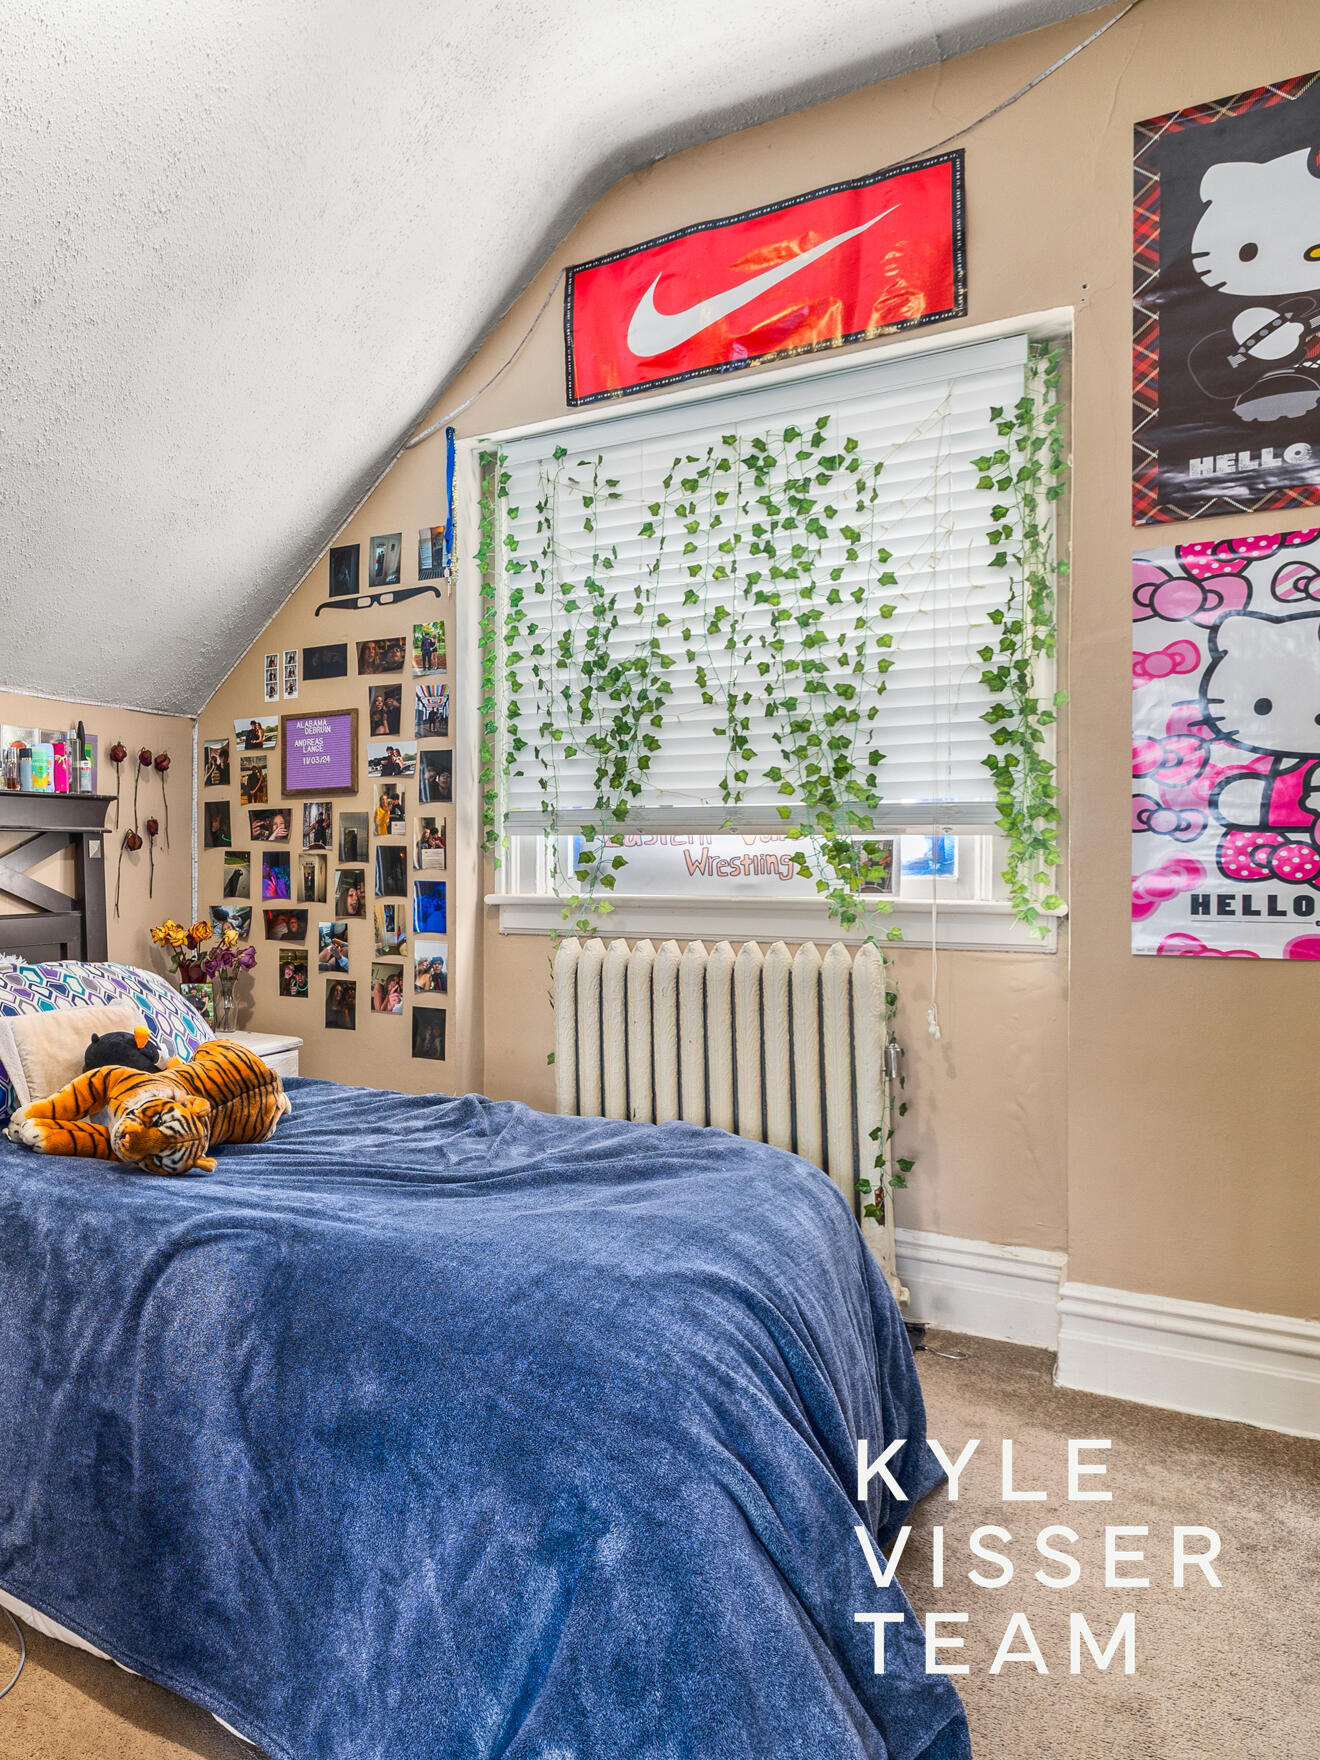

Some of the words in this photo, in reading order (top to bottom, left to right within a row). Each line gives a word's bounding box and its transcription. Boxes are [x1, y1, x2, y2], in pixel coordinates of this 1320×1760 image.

[1189, 442, 1313, 478] HELLO
[296, 719, 328, 729] ALABAMA
[294, 738, 324, 747] ANDREAS
[302, 745, 324, 753] LANGE
[683, 847, 795, 881] Wrestling
[1190, 893, 1316, 918] HELLO
